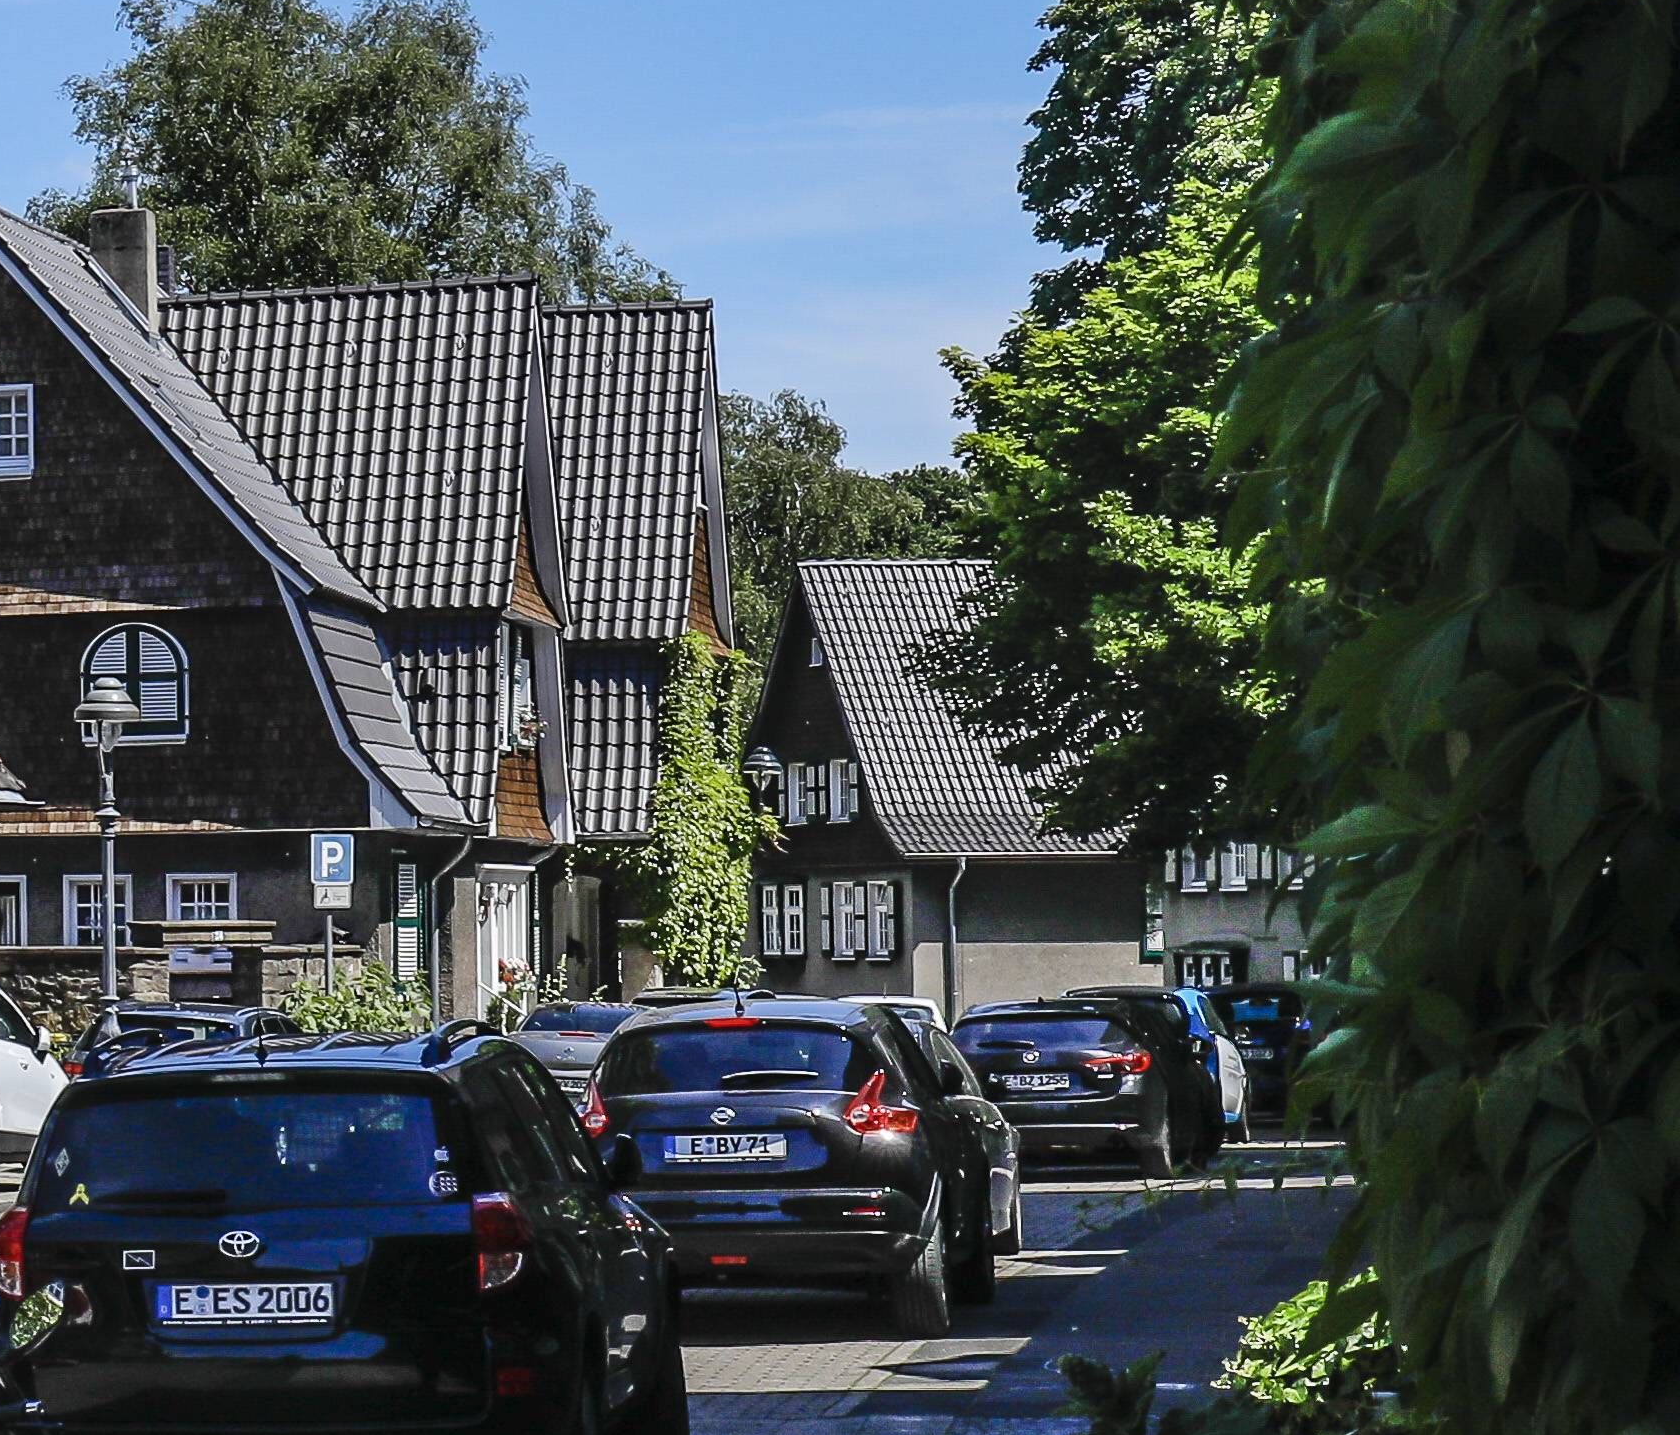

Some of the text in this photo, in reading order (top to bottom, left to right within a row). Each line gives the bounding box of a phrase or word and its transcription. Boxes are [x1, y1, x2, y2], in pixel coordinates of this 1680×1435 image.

[321, 841, 344, 878] P
[690, 1136, 770, 1155] E BY 71
[174, 1285, 330, 1315] E ES 2006
